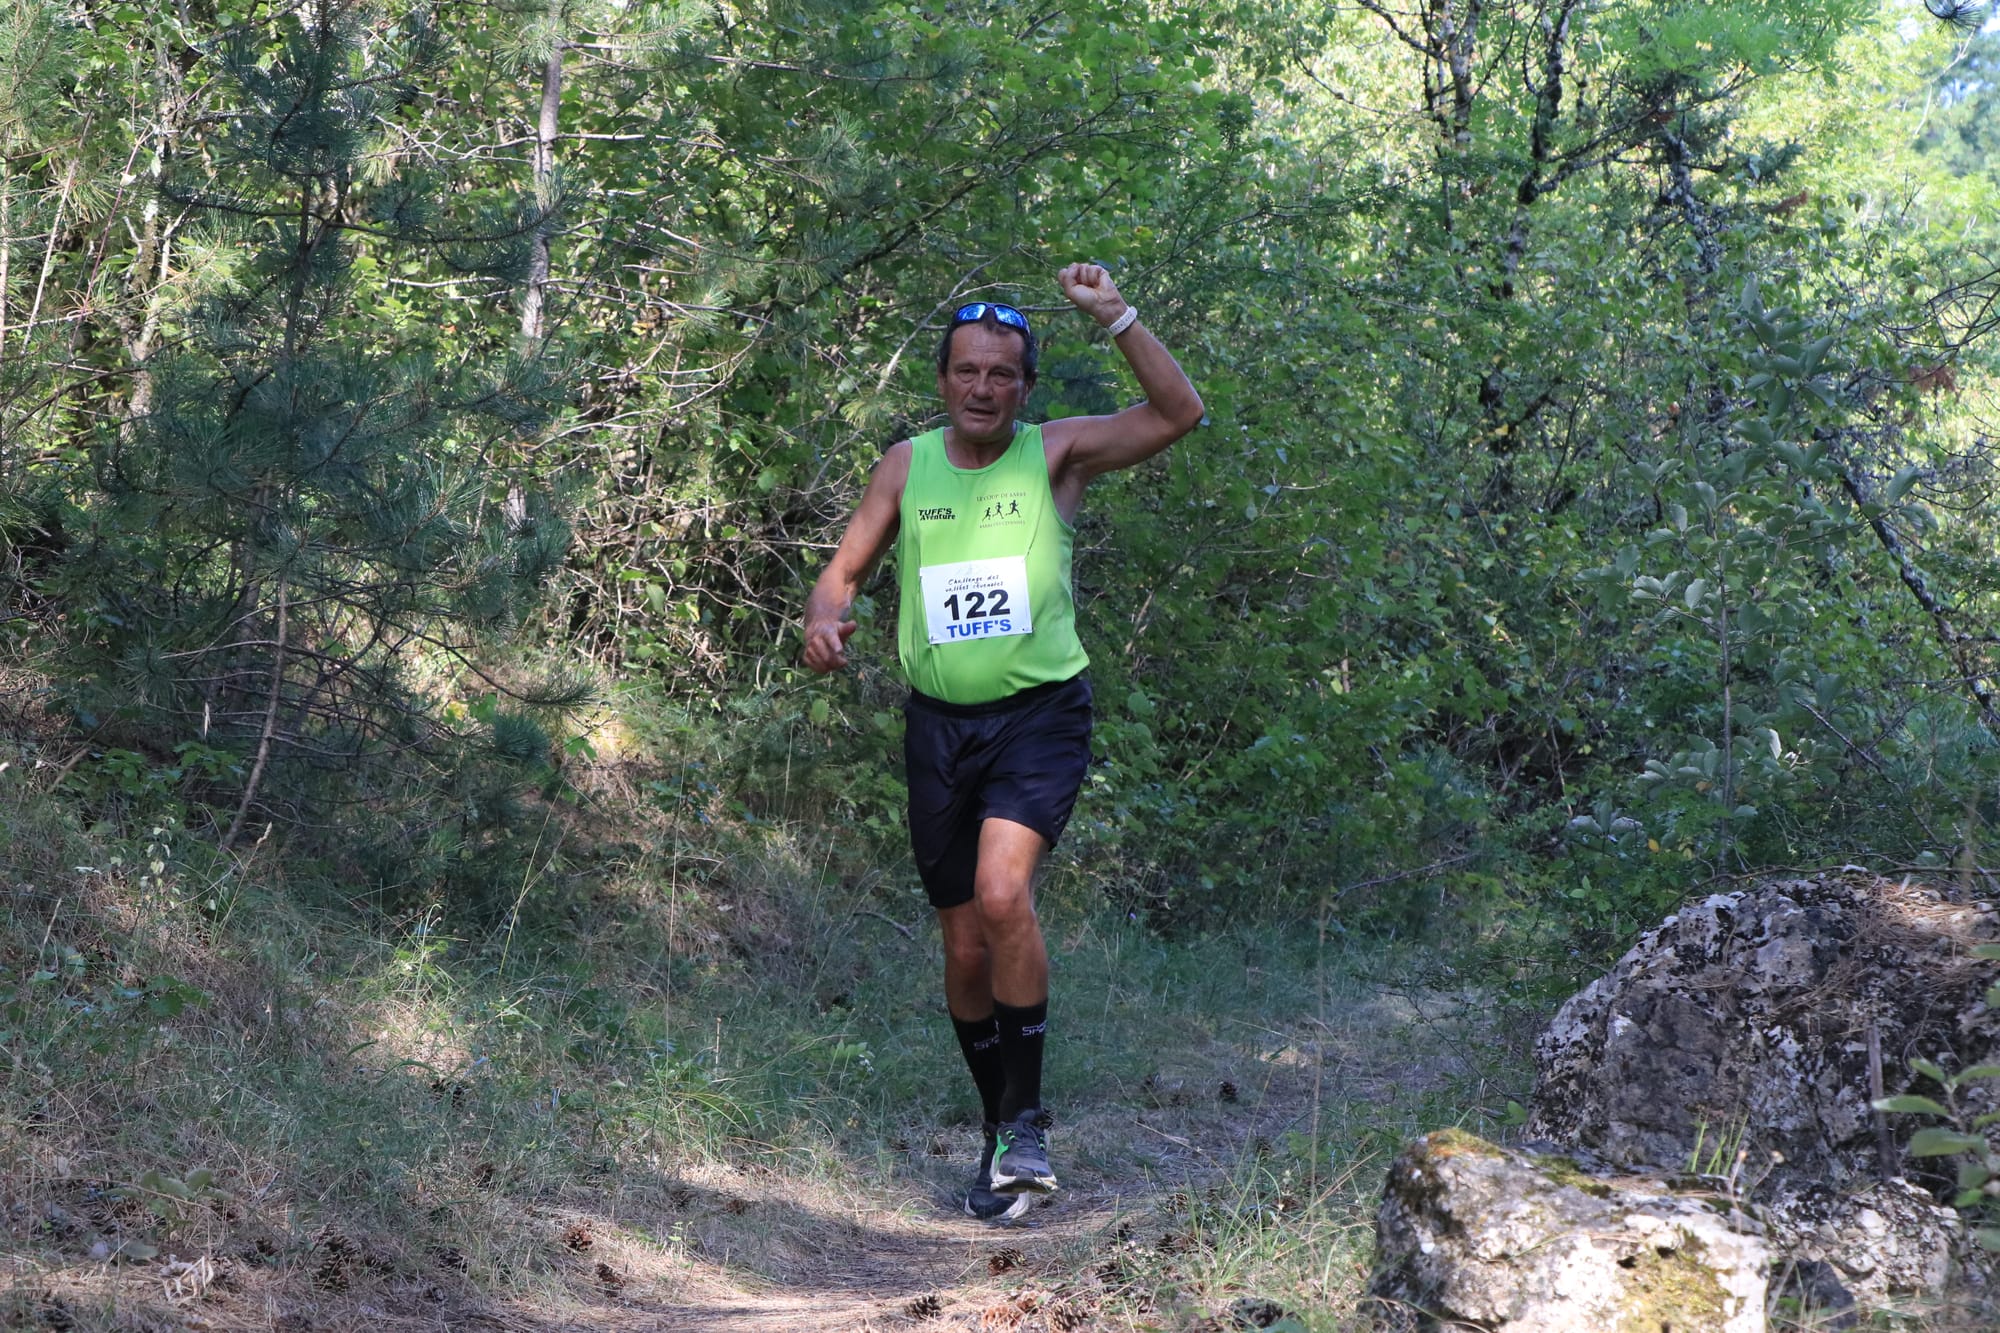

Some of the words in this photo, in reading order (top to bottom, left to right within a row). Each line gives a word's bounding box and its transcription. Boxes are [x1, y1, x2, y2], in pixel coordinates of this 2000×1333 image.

[918, 508, 952, 516] TUFF'S
[948, 577, 983, 585] Challenge
[944, 589, 1011, 621] 122
[946, 619, 1012, 638] TUFF'S
